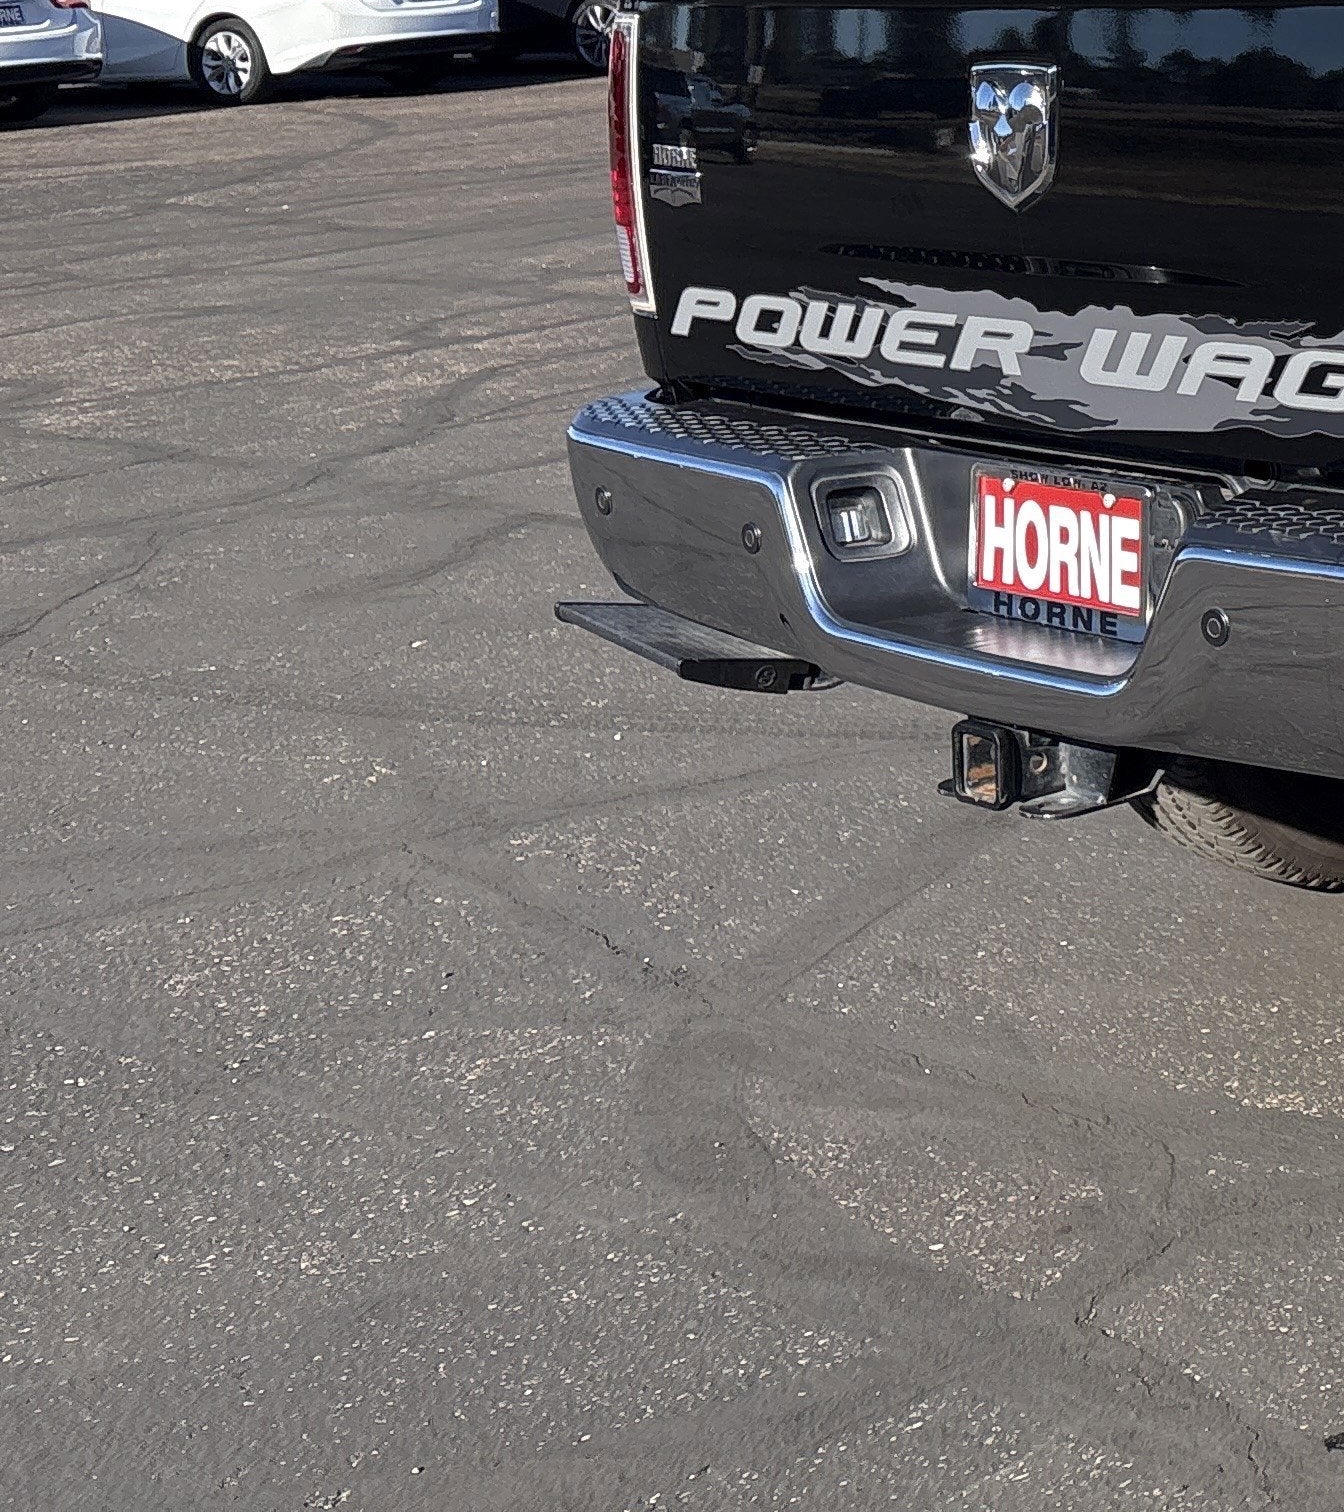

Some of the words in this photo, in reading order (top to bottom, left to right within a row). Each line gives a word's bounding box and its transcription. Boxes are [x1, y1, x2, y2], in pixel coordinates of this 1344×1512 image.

[671, 287, 1033, 377] POWER
[982, 494, 1140, 609] HORNE
[993, 593, 1118, 637] HORNE
